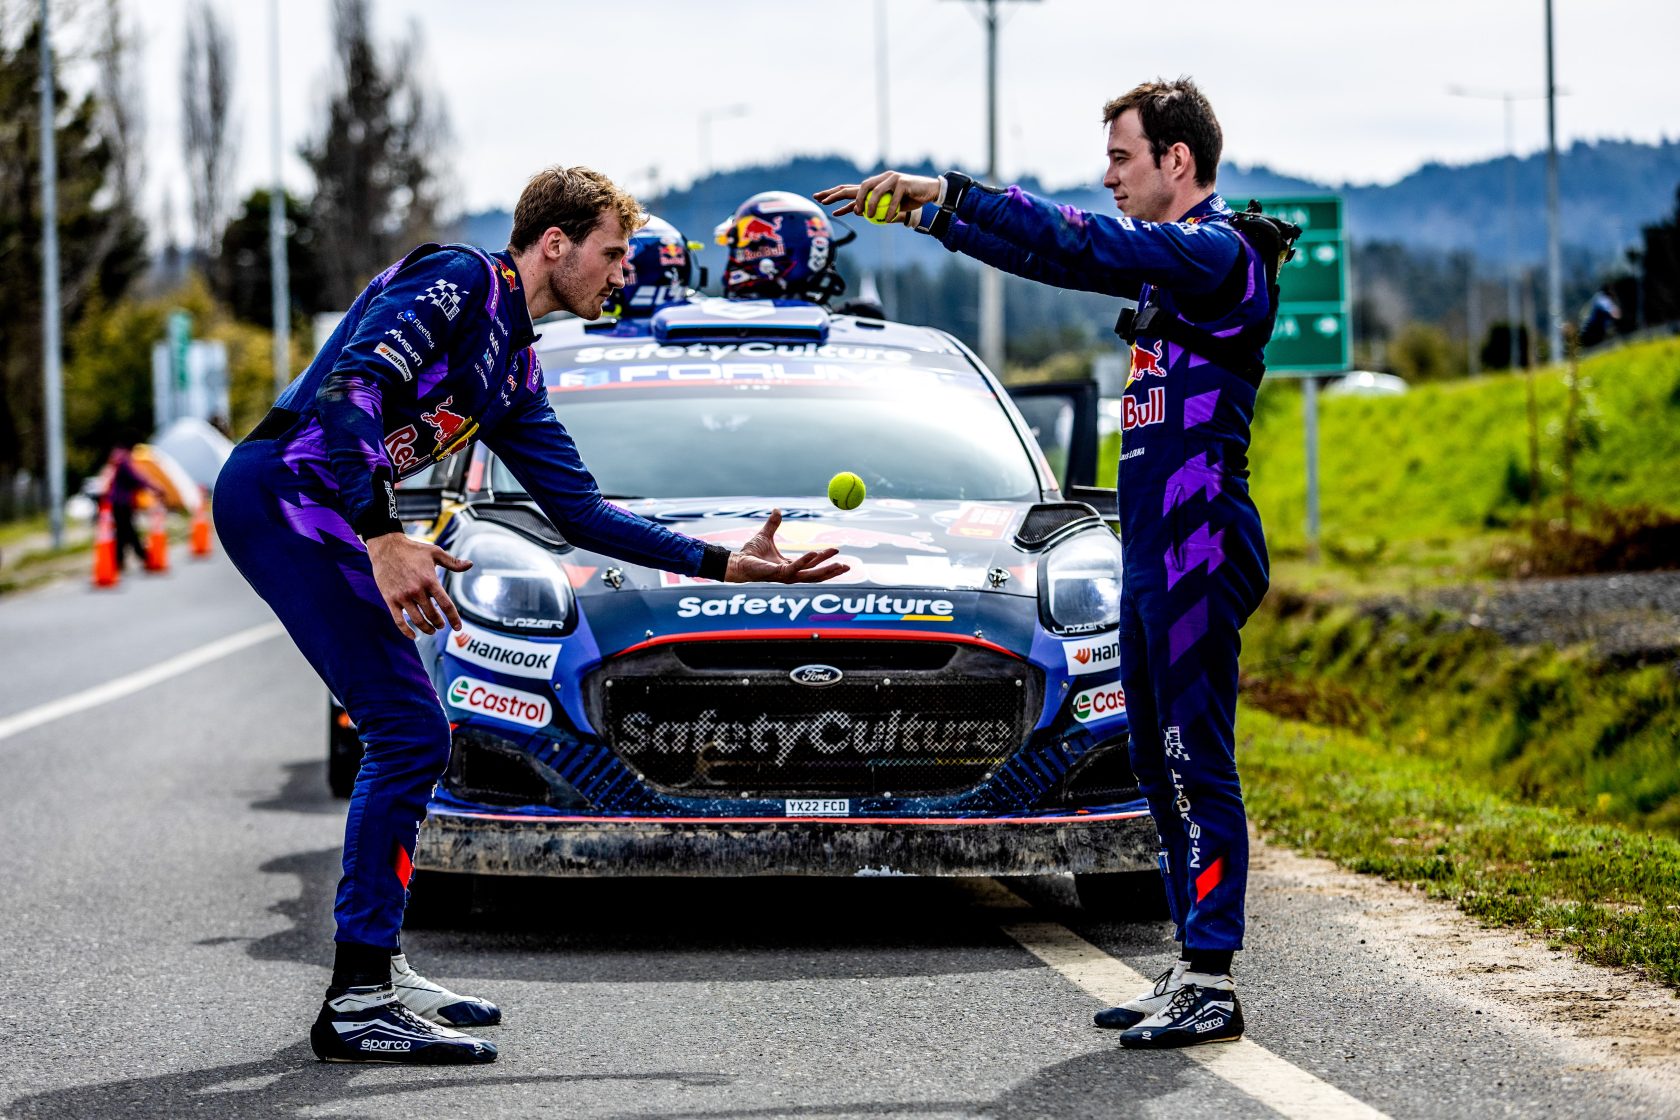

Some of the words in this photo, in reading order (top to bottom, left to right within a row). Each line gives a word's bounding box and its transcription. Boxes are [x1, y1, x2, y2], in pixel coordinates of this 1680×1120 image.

[575, 342, 913, 363] SafetyCulture
[1121, 386, 1166, 431] Bull
[384, 479, 399, 520] sparco
[677, 594, 954, 621] SafetyCulture
[502, 616, 565, 630] LAZER
[1052, 622, 1106, 634] LAZER
[801, 668, 832, 682] Ford
[469, 687, 546, 723] Castrol
[618, 709, 1012, 768] SafetyCulture
[789, 801, 819, 812] YX22
[823, 801, 846, 812] FCD
[1195, 1016, 1225, 1034] sparco
[360, 1038, 412, 1053] sparco
